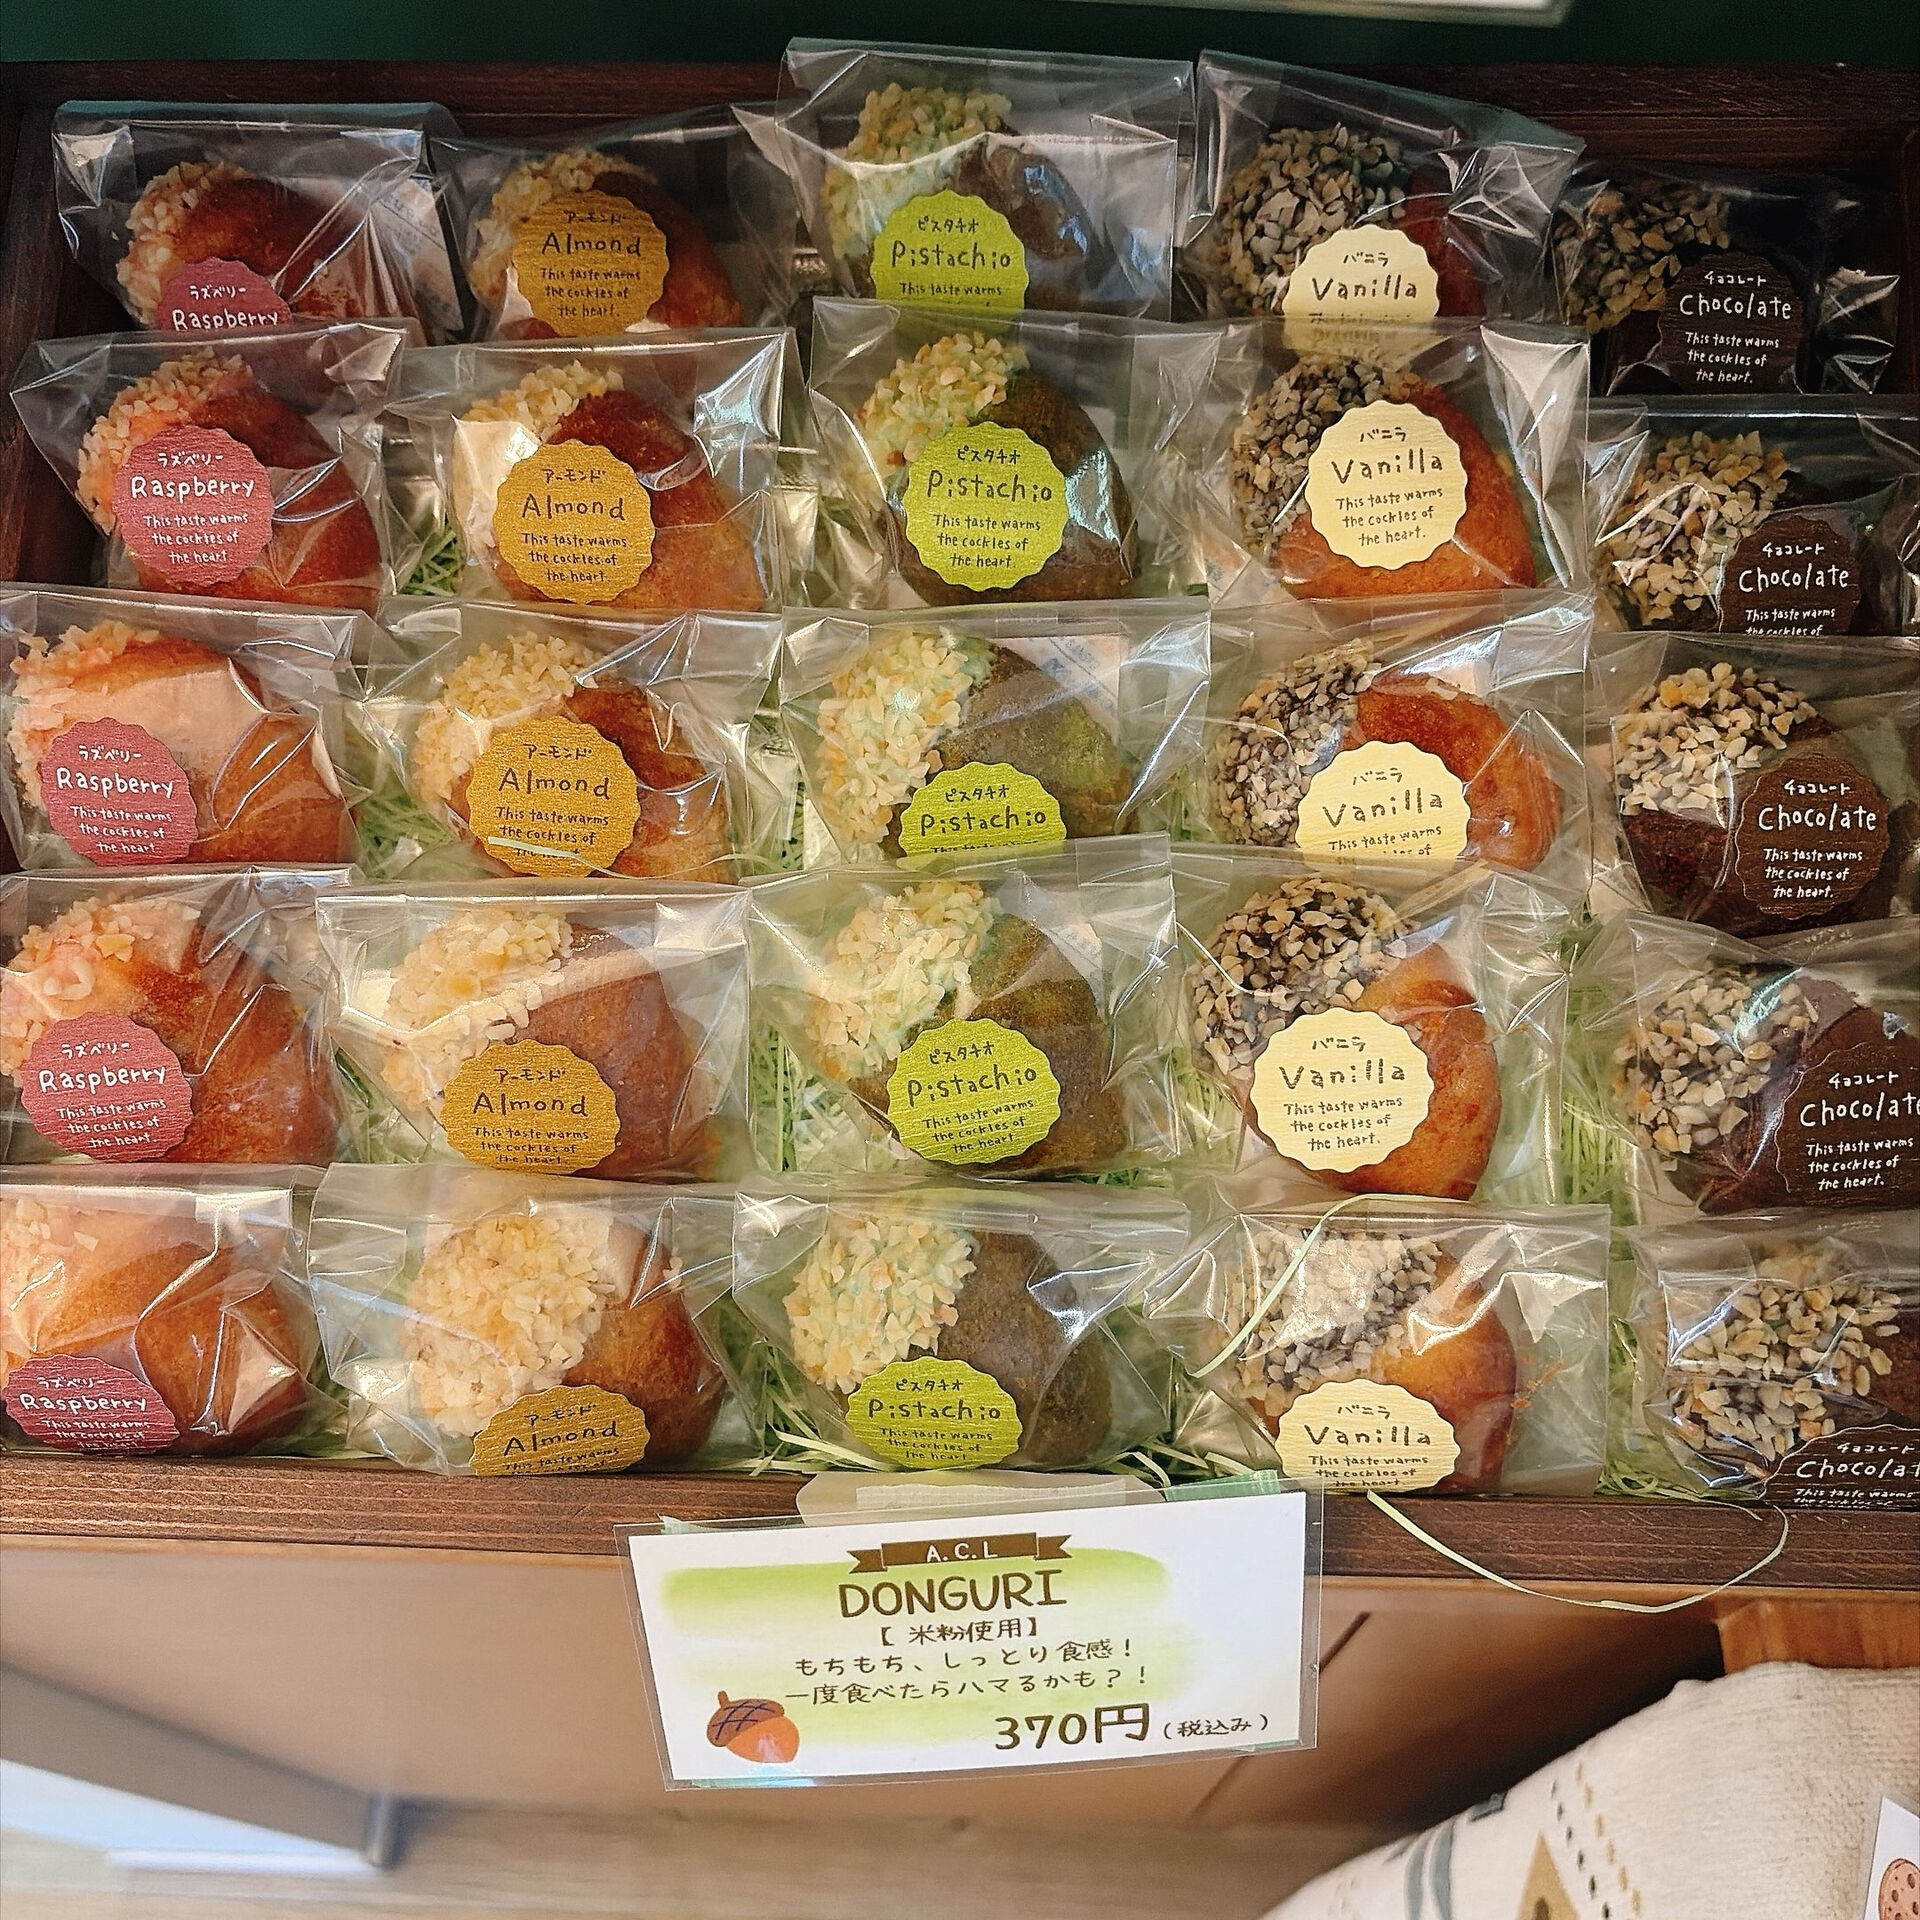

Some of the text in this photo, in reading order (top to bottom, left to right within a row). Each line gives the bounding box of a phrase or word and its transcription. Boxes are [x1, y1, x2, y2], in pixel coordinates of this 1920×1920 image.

[563, 209, 626, 224] アーモンド
[918, 216, 979, 232] ピスタチオ
[542, 232, 641, 256] Almond
[892, 240, 1011, 270] Pistachio
[1343, 251, 1389, 266] バニラ
[540, 267, 641, 280] This taste warms
[1704, 271, 1767, 285] チョコレート
[190, 285, 246, 300] ラズベリー
[545, 286, 629, 298] the cockles of
[899, 282, 1002, 295] This taste warms
[1312, 274, 1417, 301] Vanilla
[557, 305, 578, 316] the
[1679, 293, 1792, 319] Chocolate
[1685, 332, 1780, 348] This taste warms
[1688, 349, 1767, 366] the cockles of
[1696, 369, 1714, 381] the
[1360, 426, 1406, 442] バニラ
[157, 453, 223, 467] ラズベリー
[957, 446, 1020, 464] ピスタチオ
[1332, 448, 1443, 484] Vanilla
[541, 469, 605, 483] アーモンド
[131, 476, 255, 503] Raspberry
[927, 470, 1052, 502] Pistachio
[522, 493, 626, 521] Almond
[1336, 487, 1444, 511] This taste warms
[143, 513, 248, 527] This taste warms
[933, 514, 1041, 531] This taste warms
[1343, 506, 1435, 529] the cockles of
[151, 532, 239, 545] the cockles of
[522, 532, 627, 547] This taste warms
[938, 533, 1028, 551] the cockles of
[1358, 533, 1380, 547] the
[169, 551, 189, 563] the
[1762, 542, 1824, 557] チョコレート
[529, 551, 618, 566] the cockles of
[950, 554, 970, 567] the
[546, 570, 567, 582] the
[1739, 563, 1849, 593] Chocolate
[79, 746, 141, 762] ラズベリー
[523, 744, 592, 759] アーモンド
[56, 767, 174, 798] Raspberry
[499, 767, 610, 800] Almond
[1352, 768, 1403, 785] バニラ
[945, 783, 1010, 802] ピスタチオ
[1784, 779, 1850, 795] チョコレート
[70, 806, 172, 822] This taste warms
[1322, 787, 1443, 827] Vanilla
[921, 805, 1046, 836] Pistachio
[1759, 803, 1877, 831] Chocolate
[79, 823, 165, 839] the cockles of
[96, 842, 117, 852] the
[1763, 848, 1863, 861] This taste warms
[1764, 866, 1850, 880] the cockles of
[1773, 886, 1793, 898] the
[61, 1041, 131, 1059] ラズベリー
[1313, 1036, 1366, 1052] バニラ
[929, 1041, 995, 1064] ピスタチオ
[39, 1066, 166, 1094] Raspberry
[494, 1069, 565, 1083] アーモンド
[1279, 1058, 1405, 1089] Vanilla
[1829, 1073, 1898, 1087] チョコレート
[908, 1064, 1037, 1107] Pistachio
[473, 1092, 588, 1116] Almond
[1284, 1097, 1402, 1115] This taste warms
[922, 1101, 1034, 1129] This taste warms
[1290, 1114, 1392, 1132] the cockles of
[932, 1118, 1027, 1142] the cockles of
[951, 1142, 974, 1153] the
[1308, 1137, 1332, 1151] the
[1806, 1138, 1913, 1156] This taste warms
[1808, 1156, 1898, 1174] the cockles of
[1818, 1178, 1840, 1191] the
[37, 1376, 106, 1388] ラズベリー
[896, 1378, 963, 1391] ピスタチオ
[20, 1394, 147, 1415] Raspberry
[869, 1399, 1001, 1420] Pistachio
[1338, 1404, 1390, 1420] バニラ
[524, 1403, 596, 1426] アーモンド
[503, 1421, 619, 1457] Almond
[1304, 1425, 1431, 1446] Vanilla
[1837, 1442, 1915, 1454] チョコレート
[926, 1541, 998, 1563] A.C.L
[838, 1569, 1067, 1618] DONGURI
[995, 1702, 1269, 1750] 370円 （税込み）
